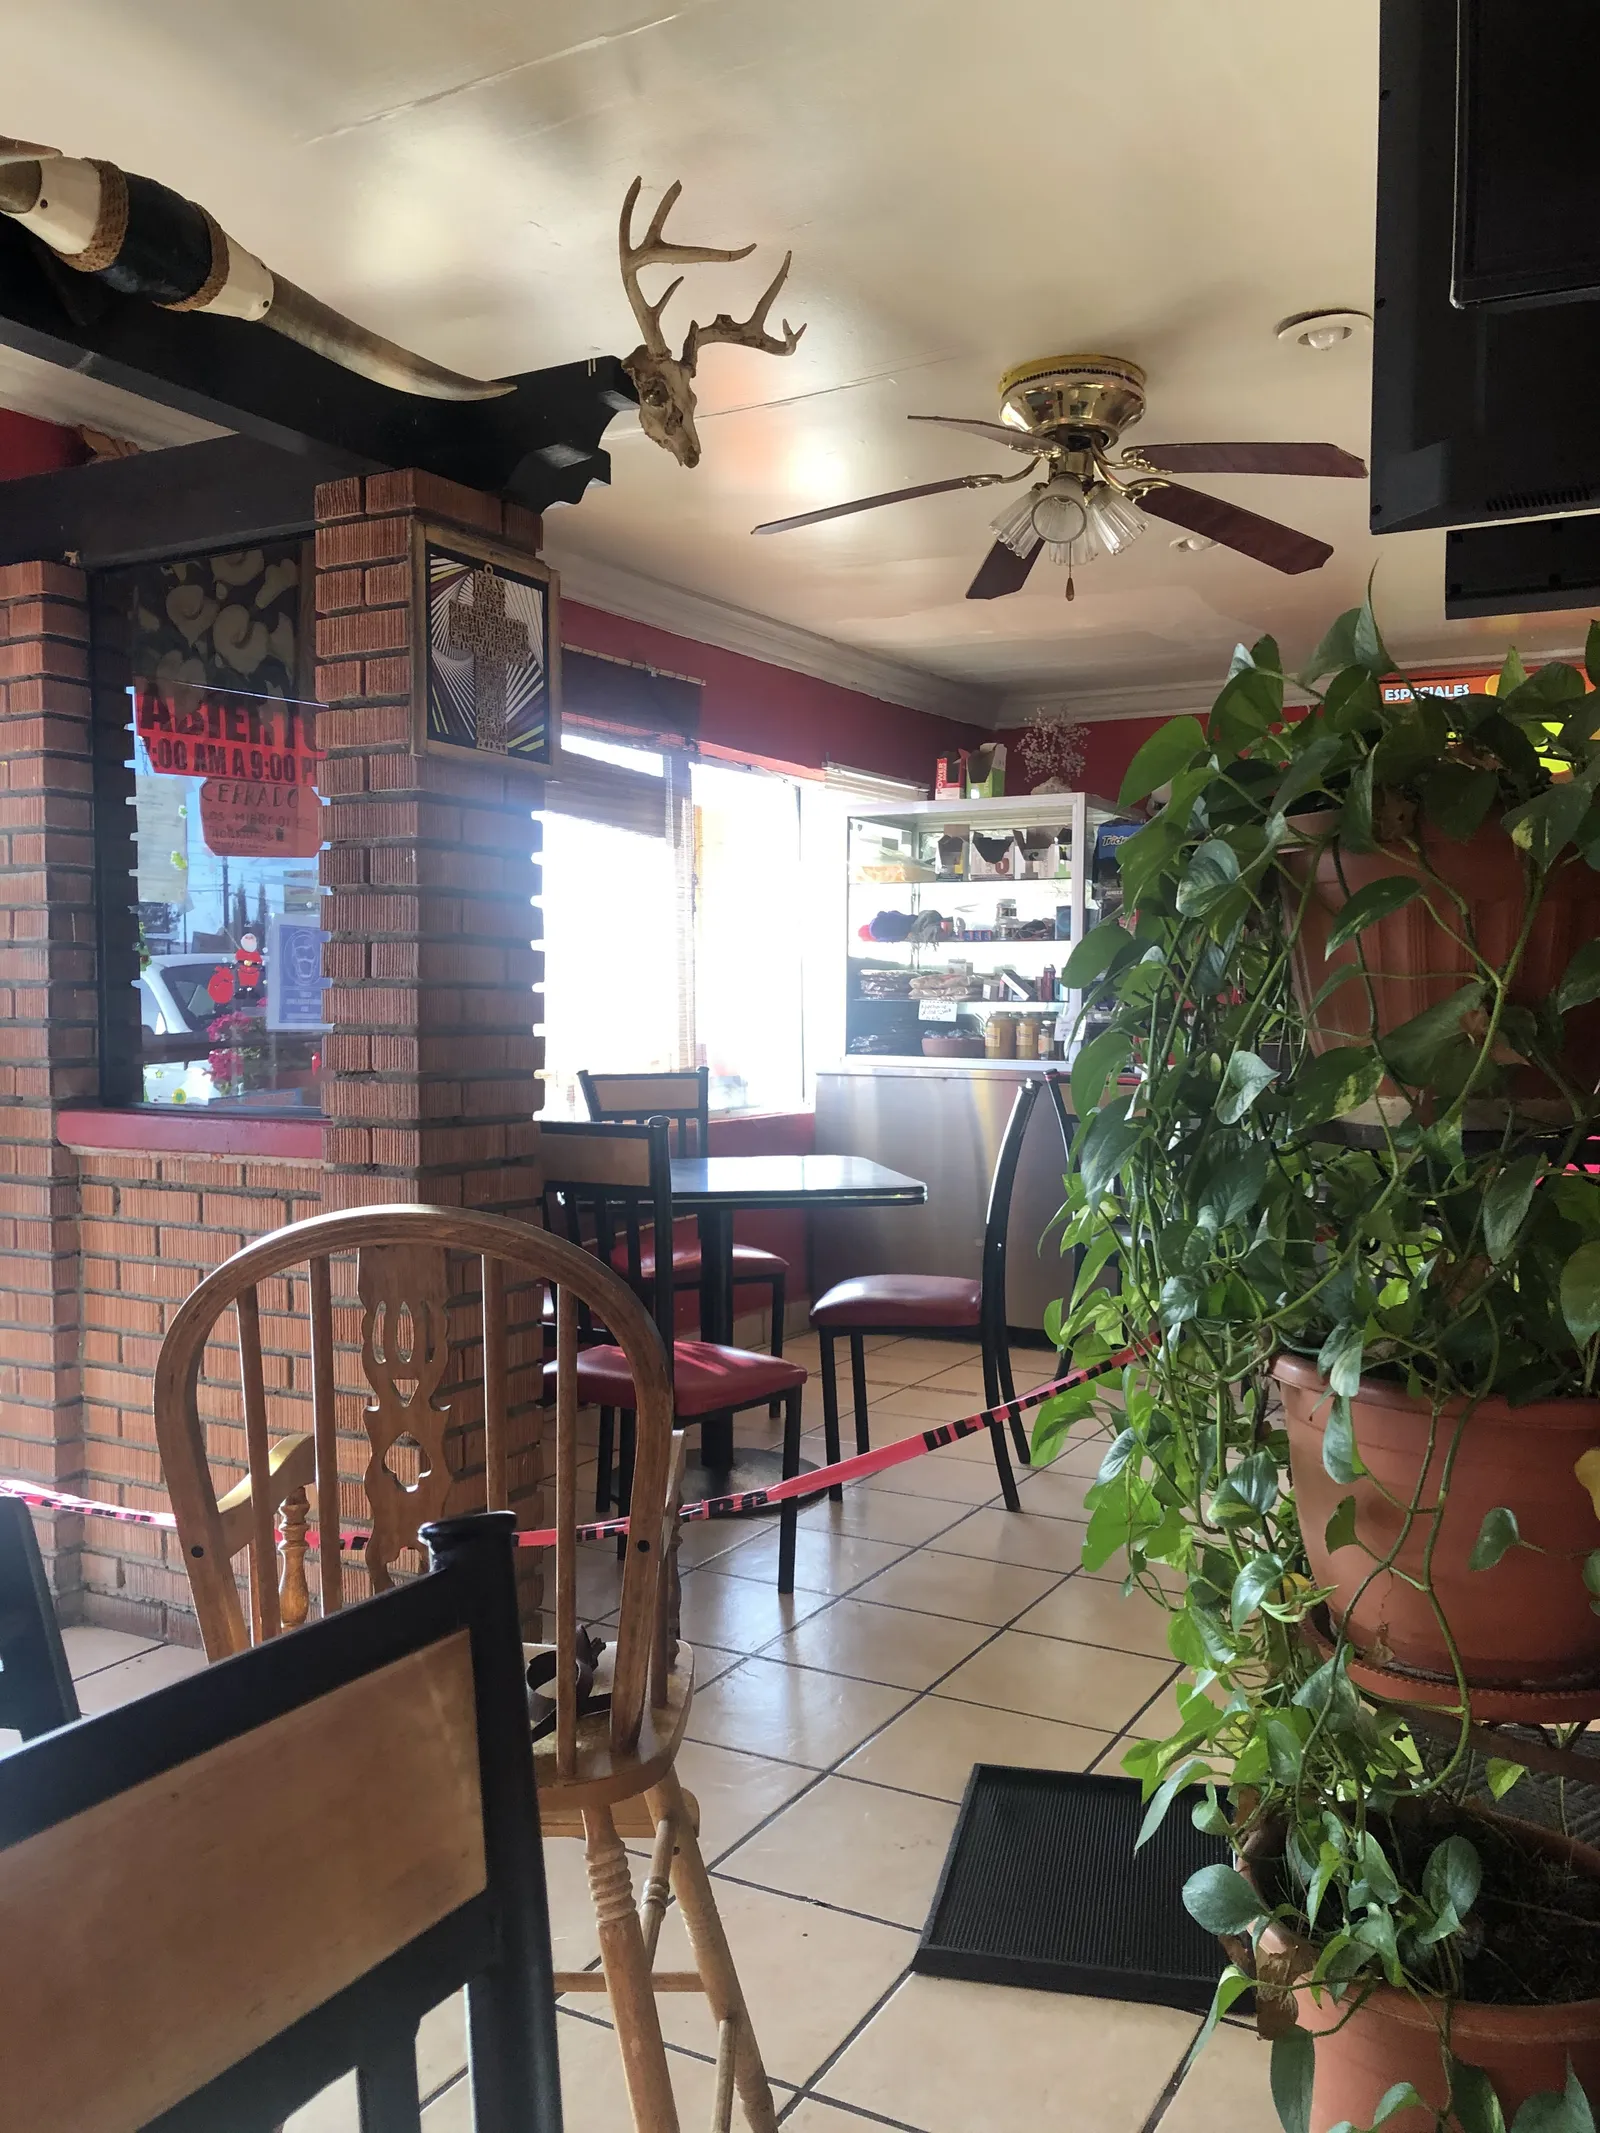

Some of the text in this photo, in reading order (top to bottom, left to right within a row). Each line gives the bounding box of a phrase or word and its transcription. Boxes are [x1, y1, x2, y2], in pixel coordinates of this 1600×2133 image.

[145, 736, 318, 785] :00 AM A 9:00 P
[1101, 834, 1128, 847] Trid
